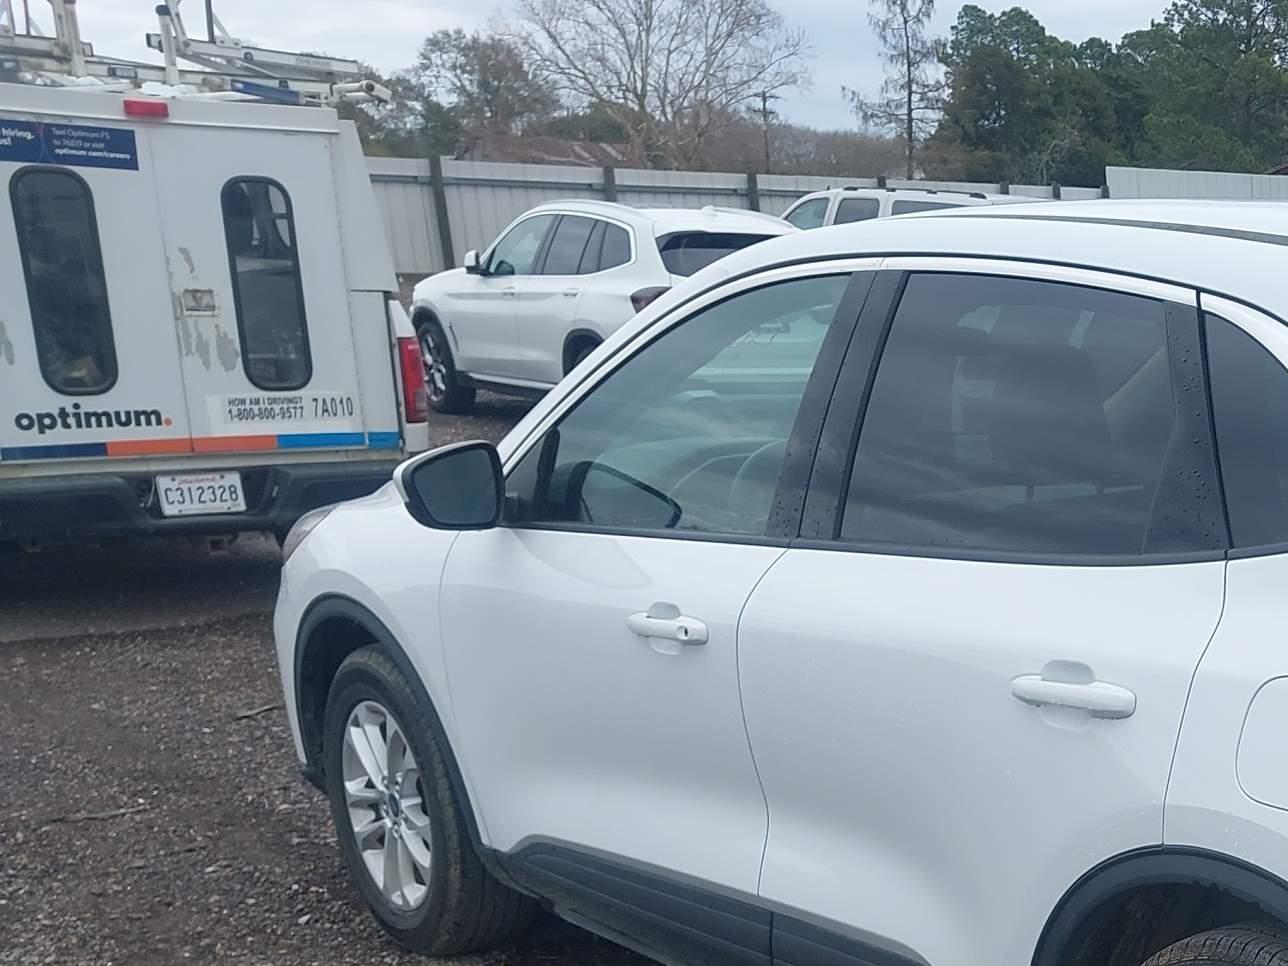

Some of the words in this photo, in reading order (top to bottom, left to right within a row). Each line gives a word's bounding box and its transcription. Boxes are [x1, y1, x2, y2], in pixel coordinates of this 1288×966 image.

[228, 397, 247, 407] HOW
[249, 397, 260, 406] AM
[267, 396, 303, 406] DRIVING?
[312, 396, 354, 418] 7A010
[228, 405, 304, 421] 1-800-800-9577
[164, 484, 239, 505] C312328
